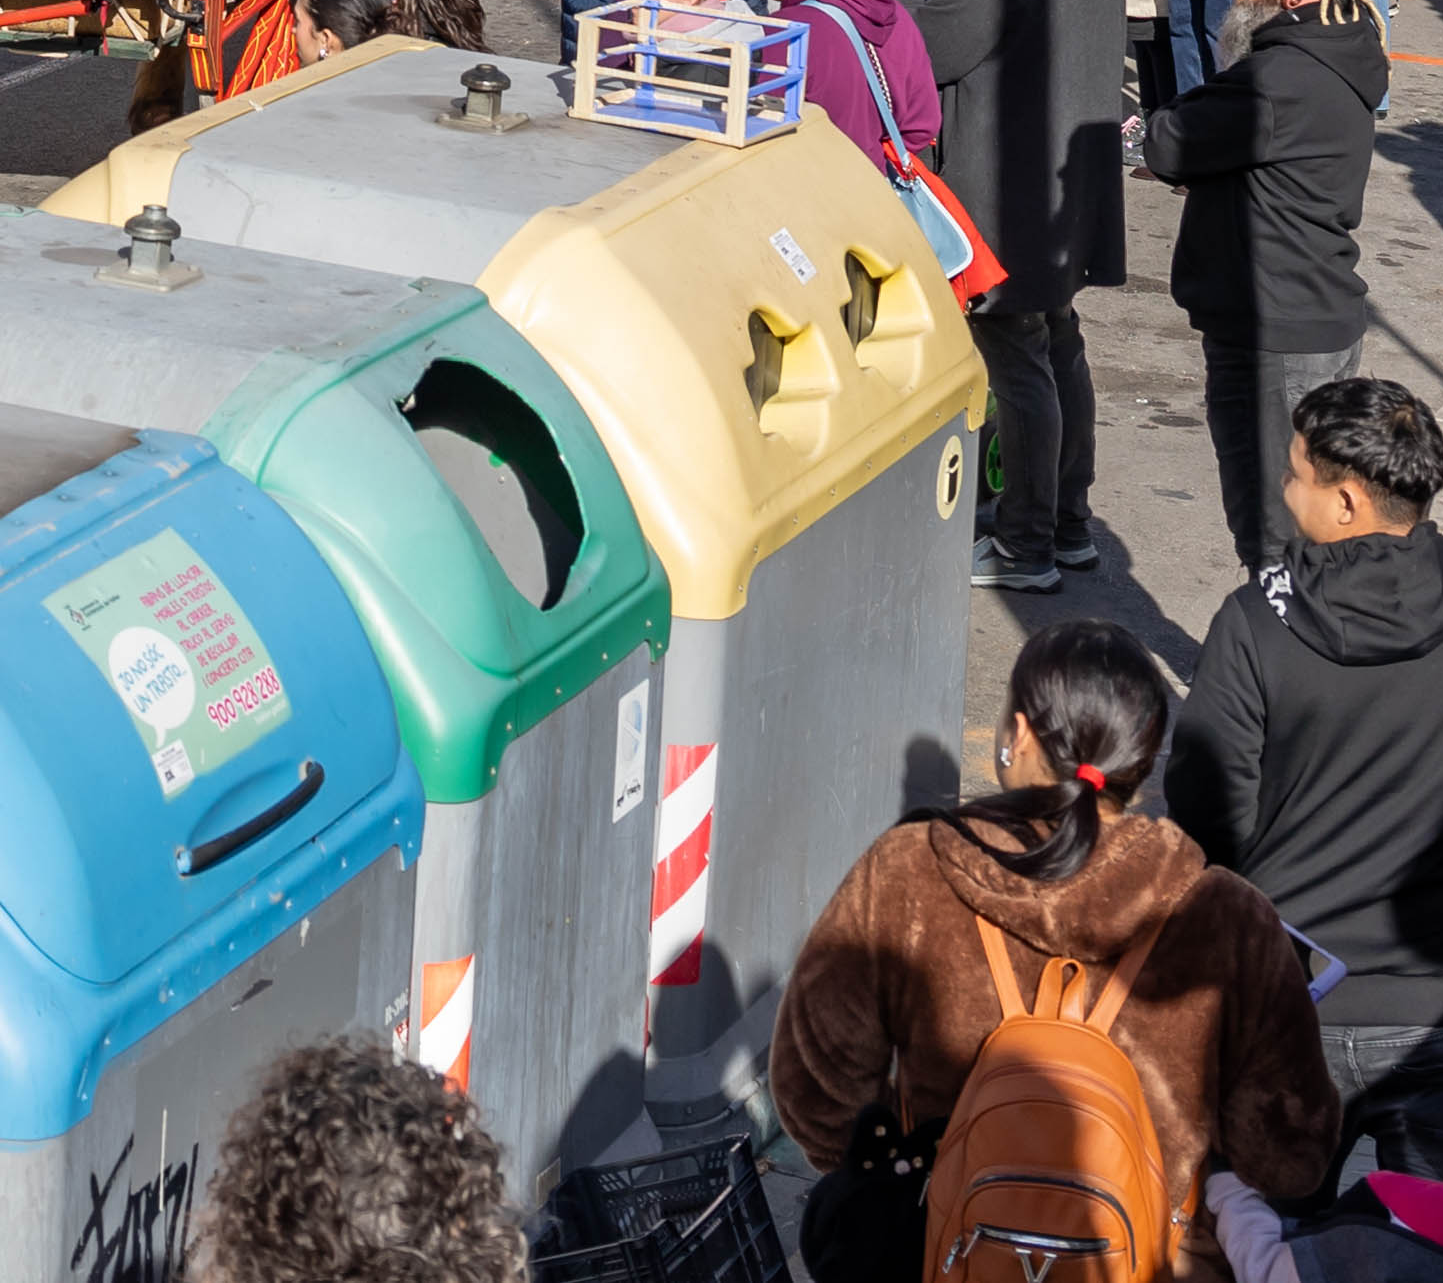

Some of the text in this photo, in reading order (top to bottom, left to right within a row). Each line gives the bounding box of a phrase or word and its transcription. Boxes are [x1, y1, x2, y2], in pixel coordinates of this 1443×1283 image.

[207, 697, 237, 730] 900
[232, 680, 259, 711] 928
[255, 666, 280, 699] 288
